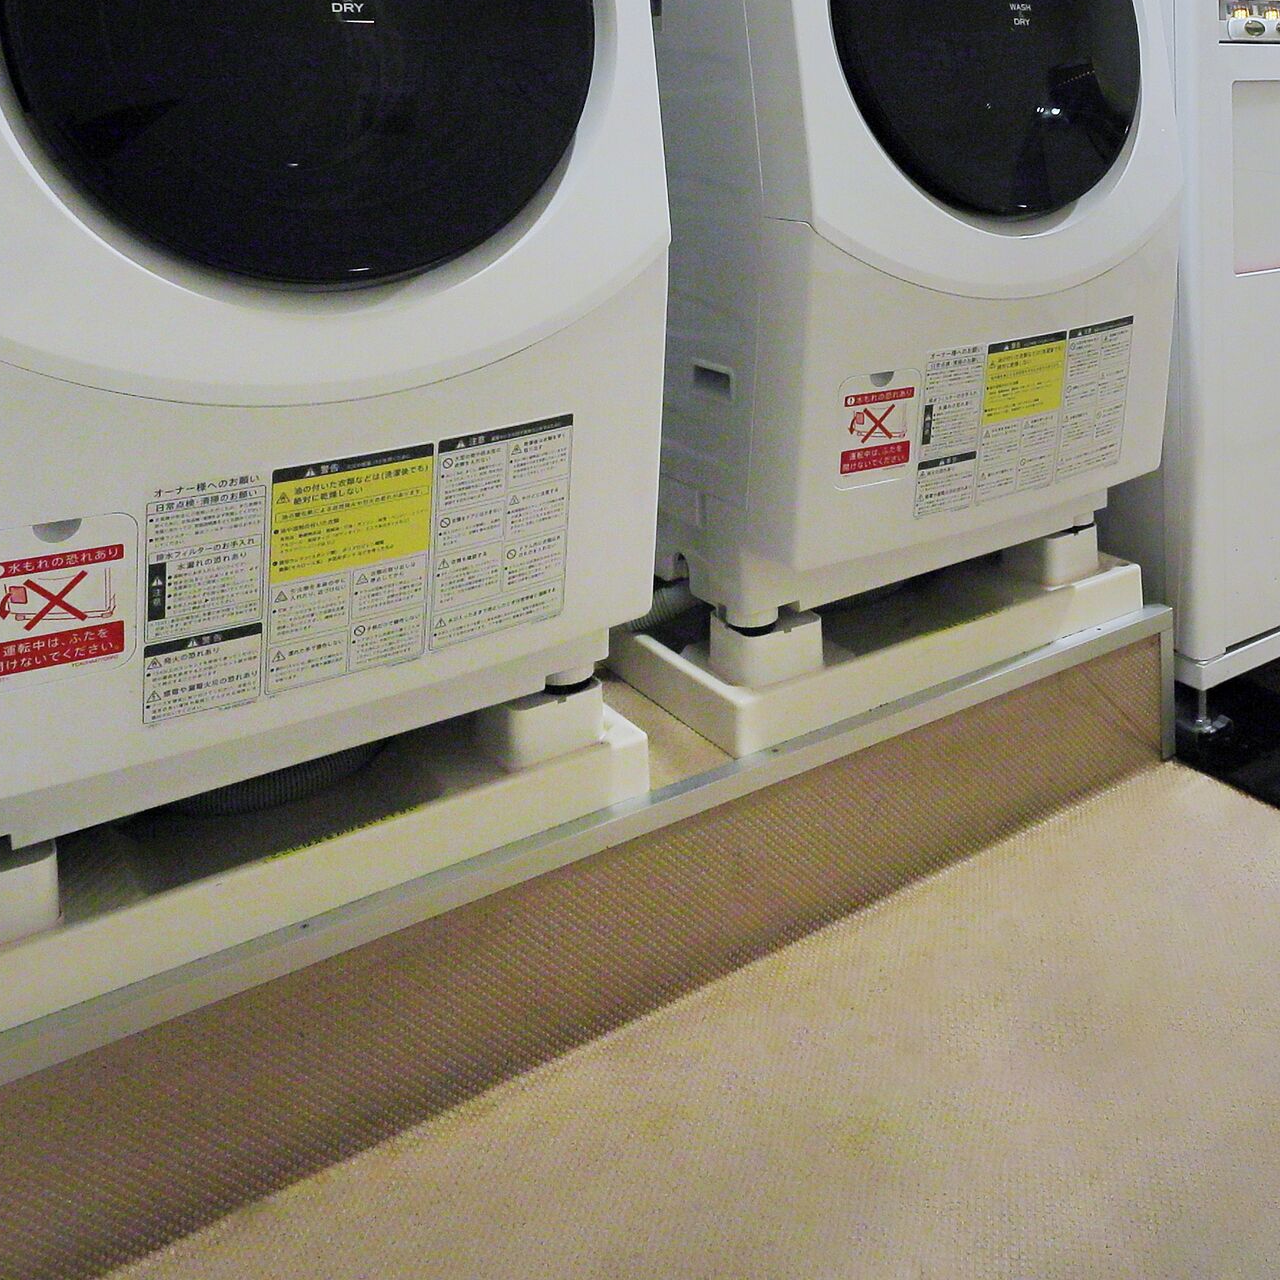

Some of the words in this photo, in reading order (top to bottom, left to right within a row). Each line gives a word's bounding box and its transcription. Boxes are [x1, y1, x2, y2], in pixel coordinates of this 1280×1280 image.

[331, 2, 364, 13] DRY
[1009, 3, 1032, 11] WASH
[1013, 18, 1030, 26] DRY
[154, 475, 260, 497] オーナー様へのお願い
[294, 464, 429, 496] 油の付いた衣類などは(洗濯後でも)
[155, 489, 258, 513] 日常点検・清掃のお願い
[293, 487, 363, 506] 絶対に乾燥しない
[8, 547, 118, 574] 水もれの恐れあり
[3, 629, 109, 657] 運転中は、ふたを
